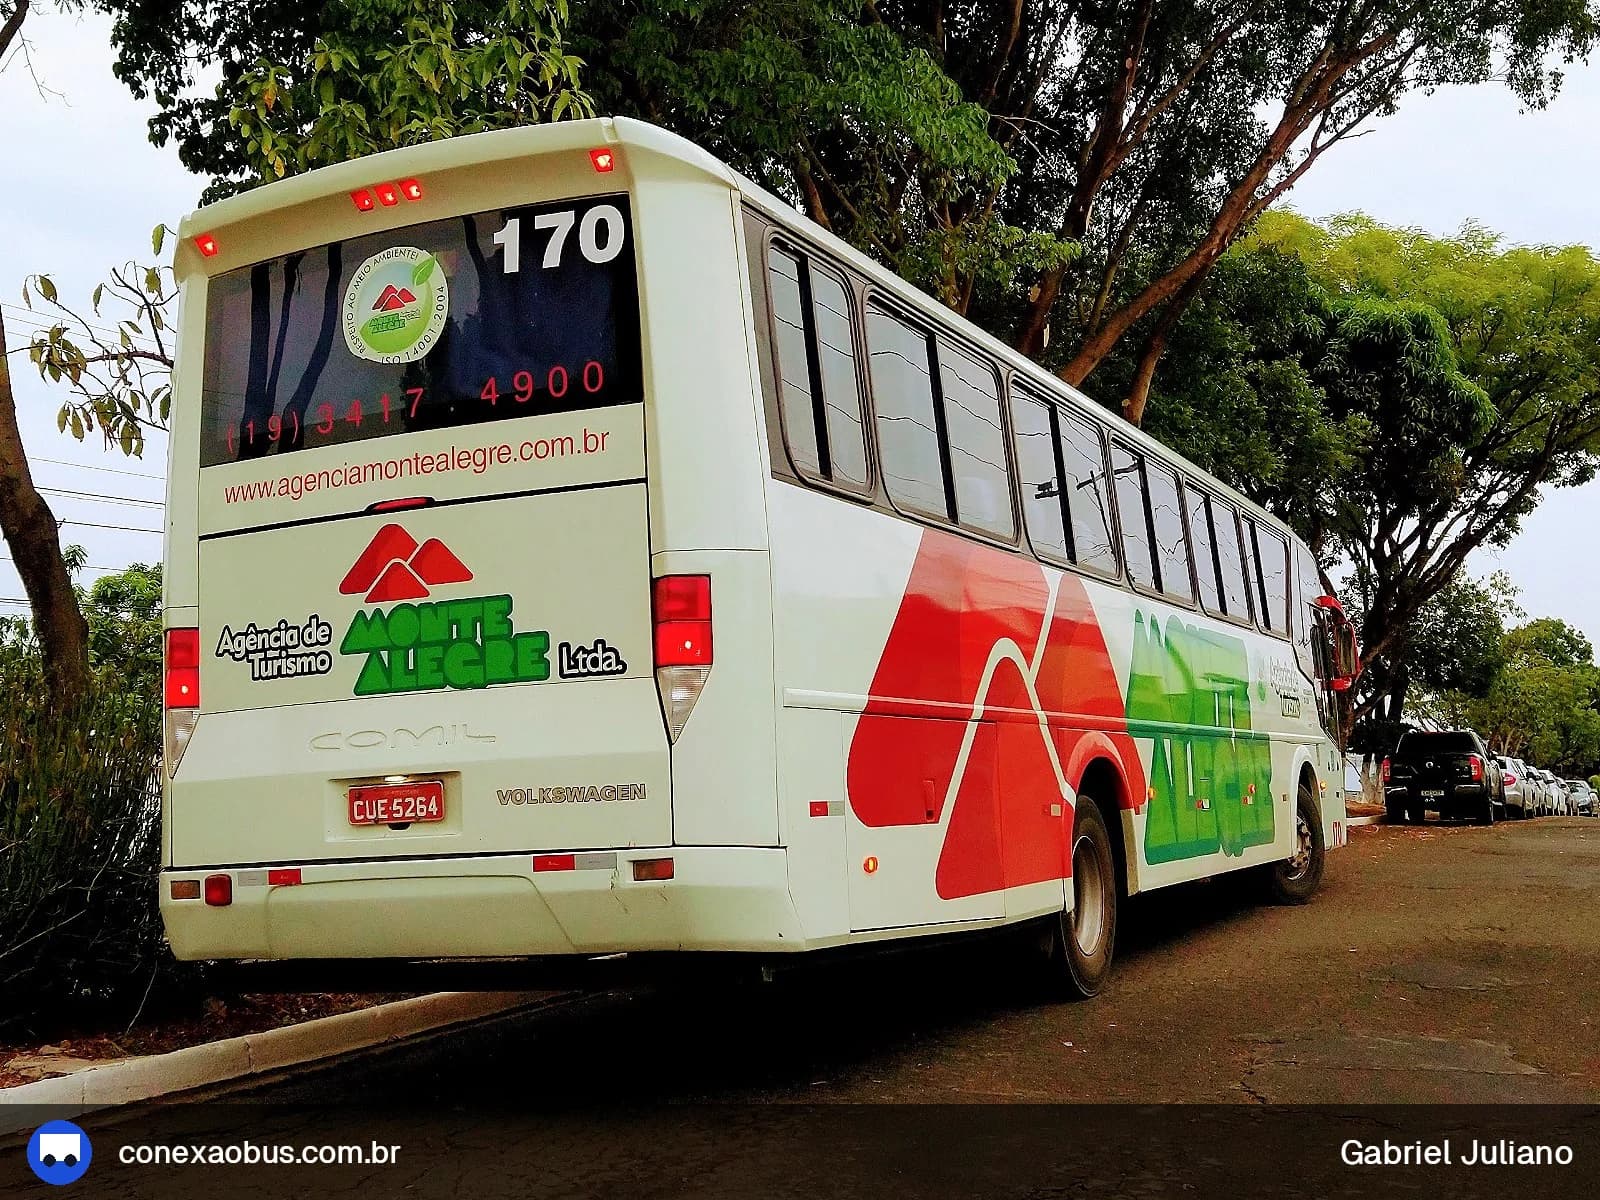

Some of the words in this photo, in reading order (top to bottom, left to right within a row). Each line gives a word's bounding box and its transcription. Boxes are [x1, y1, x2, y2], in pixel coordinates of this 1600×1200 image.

[493, 204, 625, 274] 170
[353, 264, 371, 290] MEIO
[347, 292, 356, 309] AO
[346, 312, 367, 355] RESPEITO
[224, 428, 611, 504] www.agenciamontealegre.com.br
[216, 619, 300, 661] Agência
[302, 615, 332, 647] de
[340, 594, 513, 655] MONTE
[247, 650, 332, 680] Turismo
[353, 630, 550, 696] ALEGRE
[559, 639, 628, 679] Ltda.
[310, 723, 496, 750] COMIL
[497, 783, 647, 806] VOLKSWAGEN
